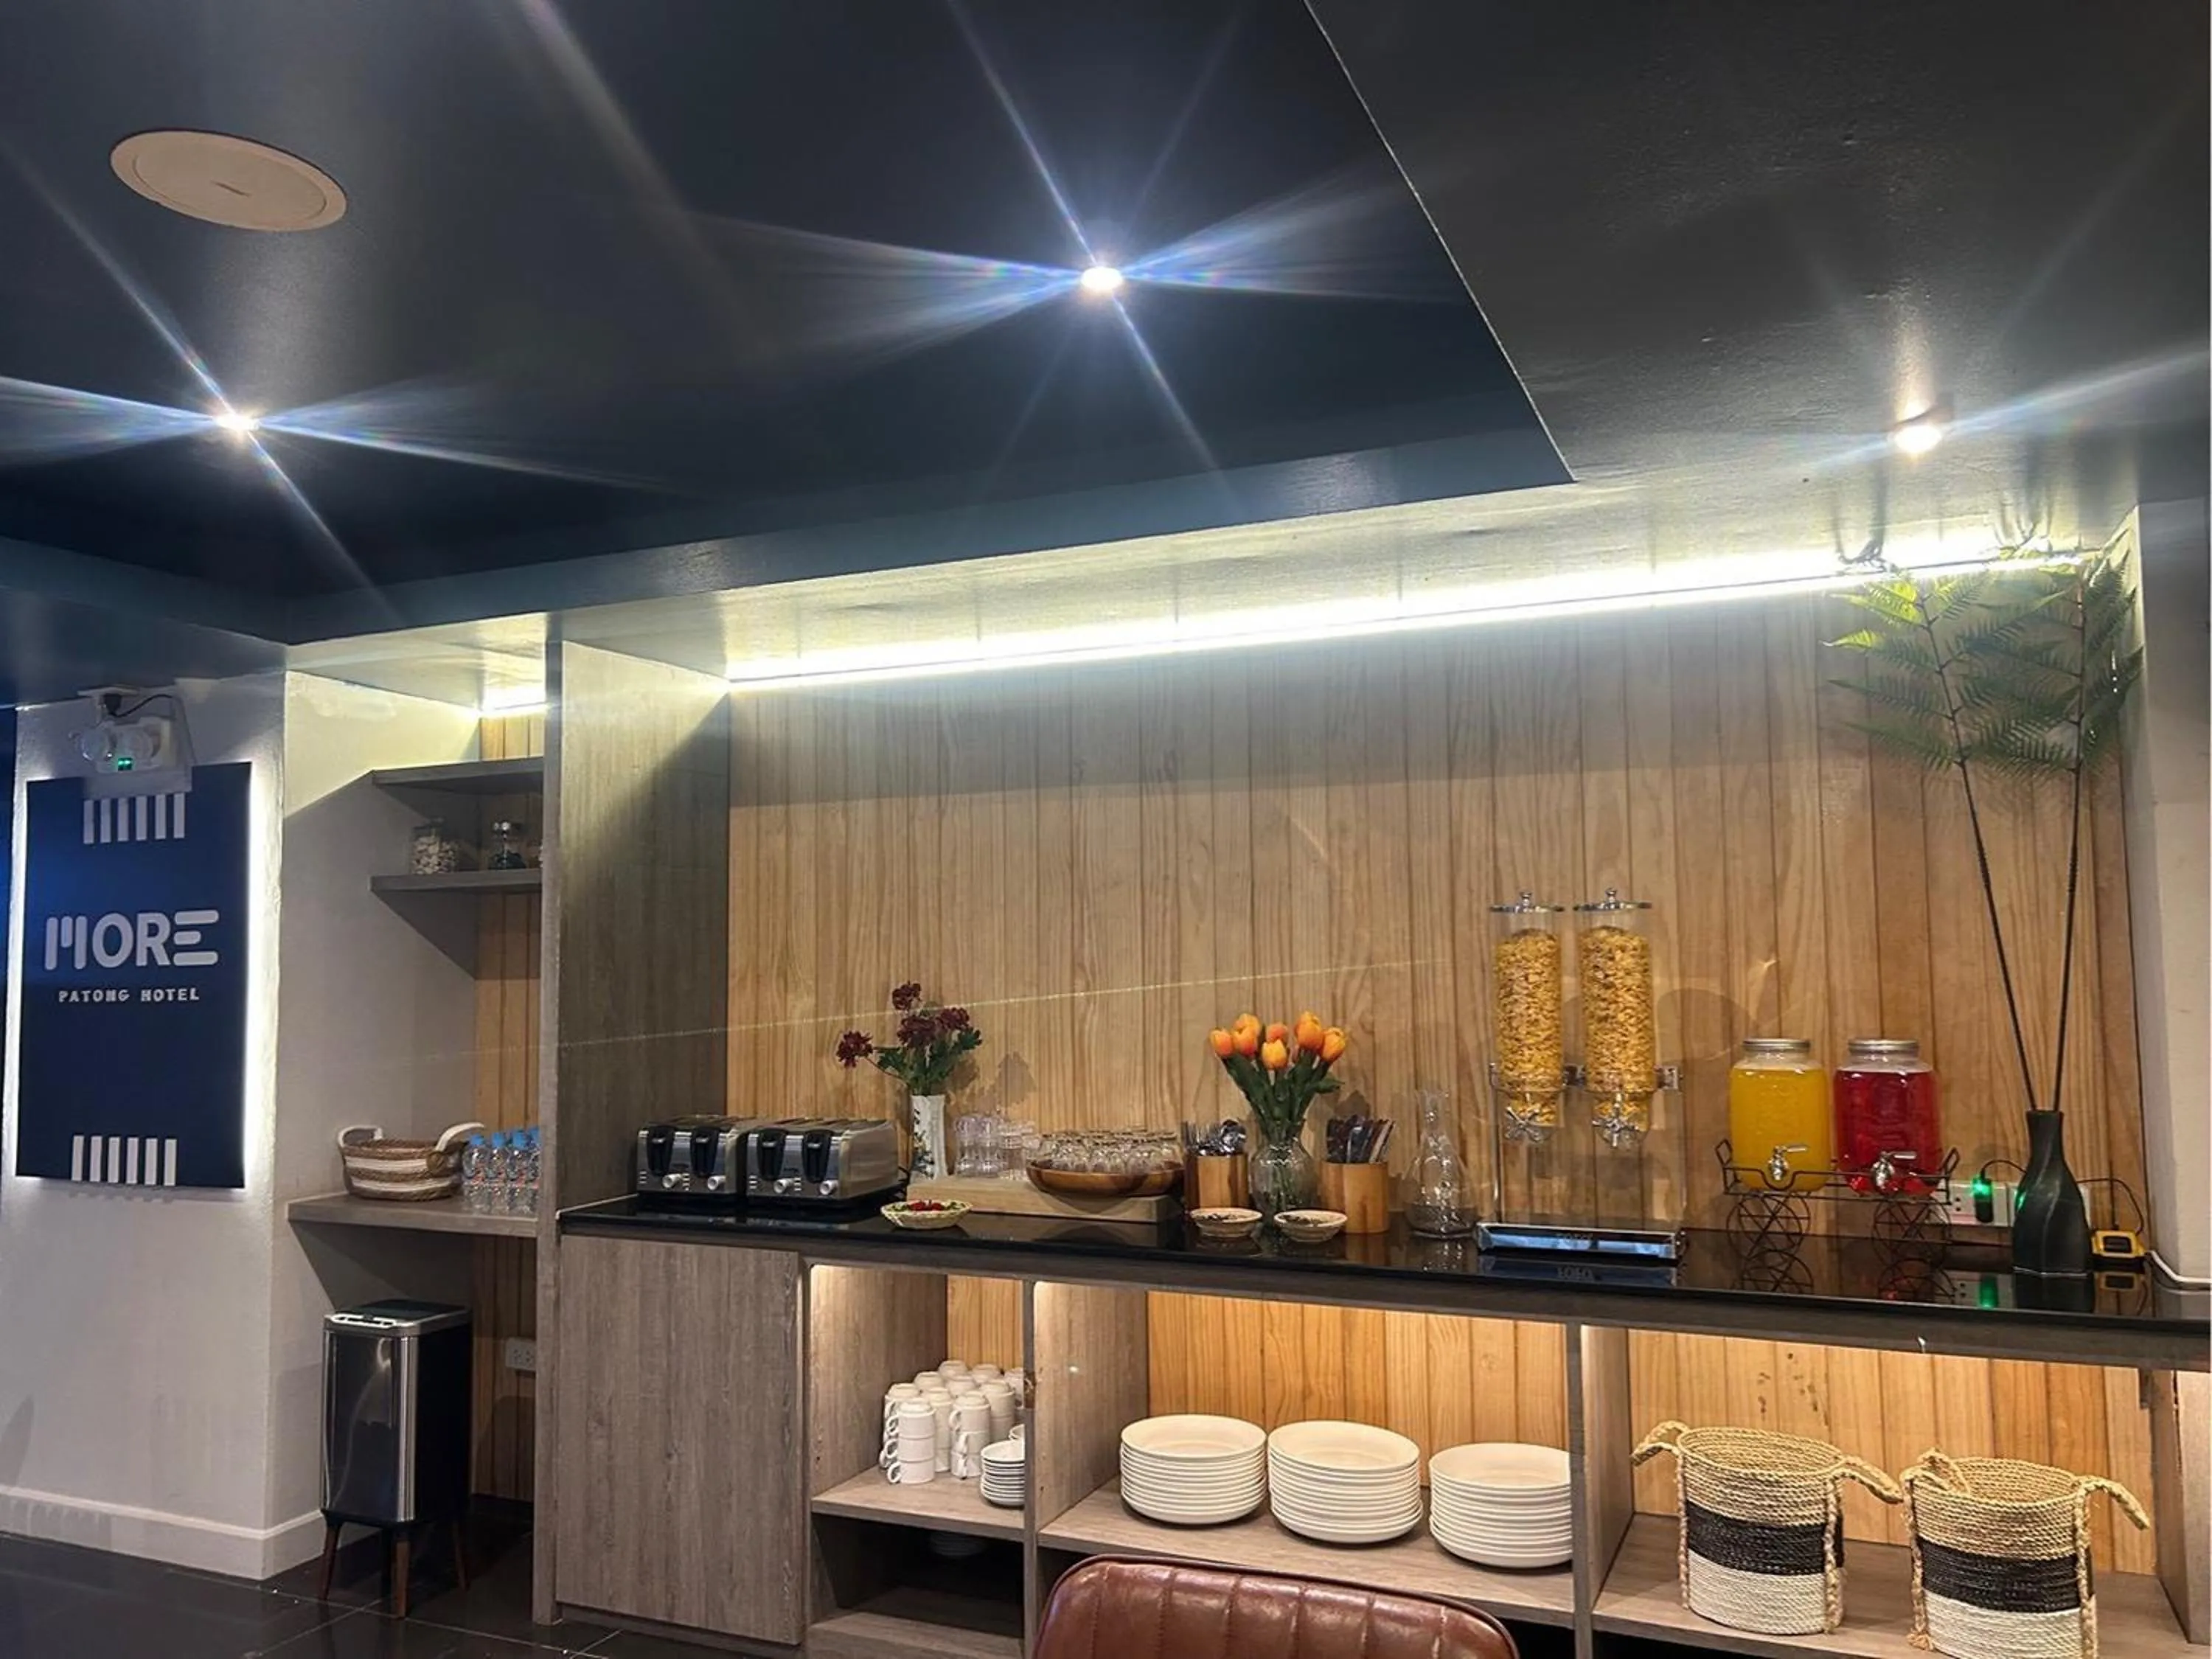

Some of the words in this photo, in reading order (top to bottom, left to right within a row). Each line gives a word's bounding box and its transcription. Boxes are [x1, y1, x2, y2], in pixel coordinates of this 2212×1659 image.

[44, 909, 220, 970] MORE
[58, 989, 131, 1003] PATONG
[140, 987, 200, 1002] HOTEL
